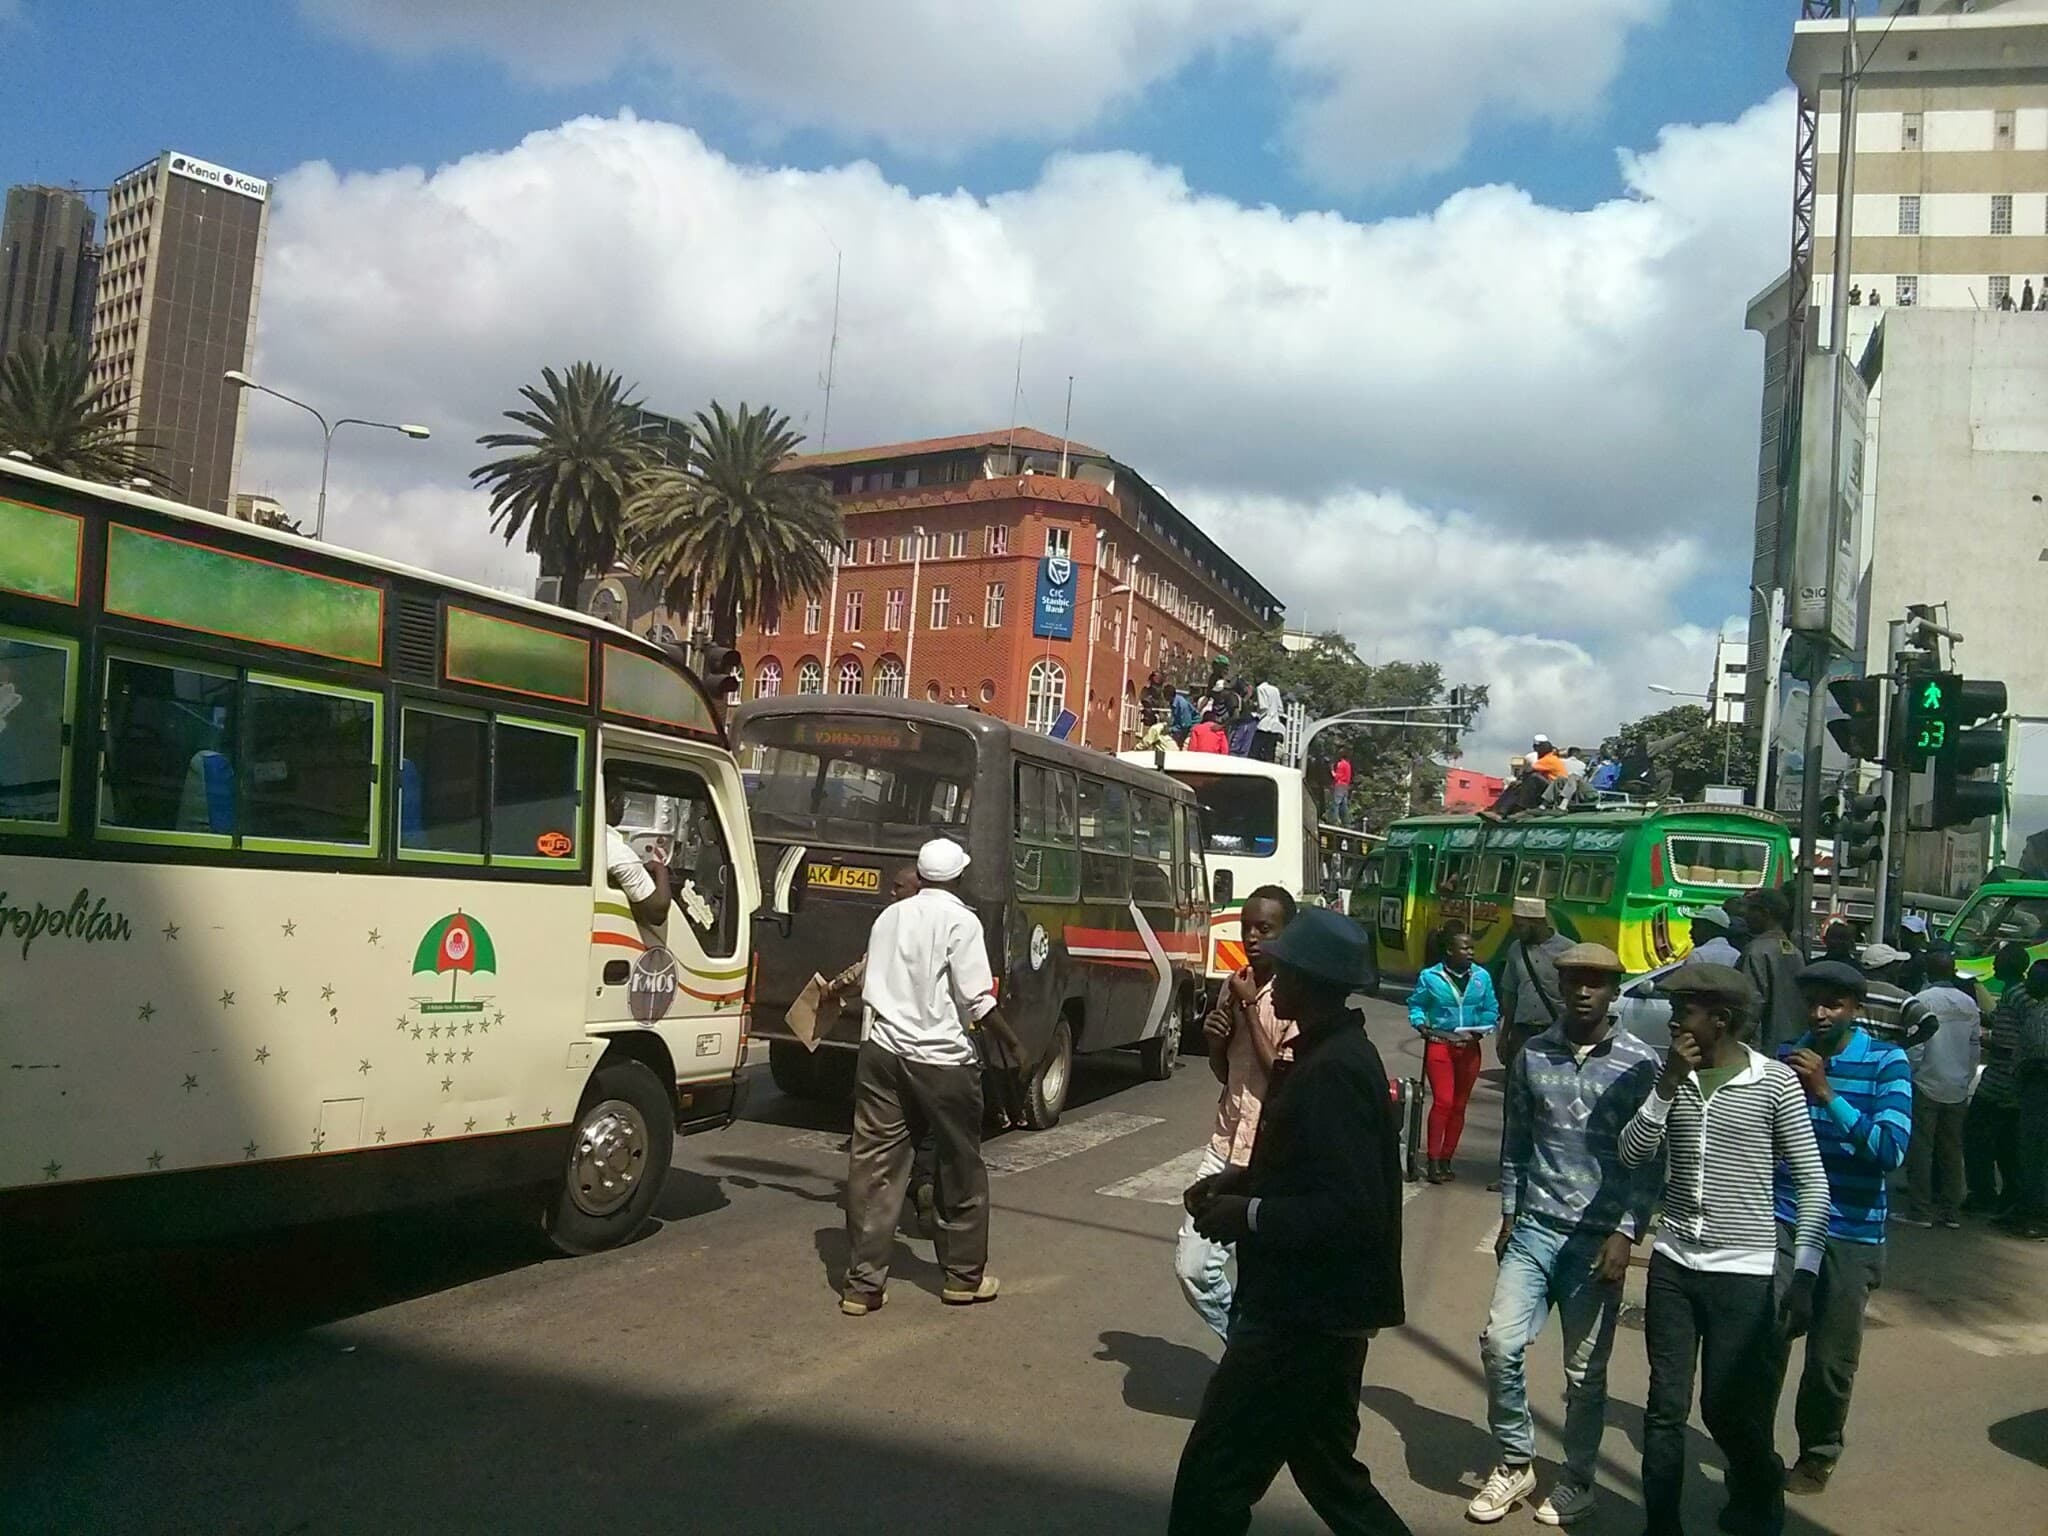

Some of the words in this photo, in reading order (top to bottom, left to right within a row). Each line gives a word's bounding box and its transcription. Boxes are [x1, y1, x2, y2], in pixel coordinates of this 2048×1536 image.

[187, 161, 220, 182] Kenol
[235, 177, 265, 196] Kobil
[1041, 596, 1070, 607] Stanbic
[1045, 604, 1064, 614] Bank
[839, 870, 878, 887] 154D
[631, 973, 675, 993] KMOS
